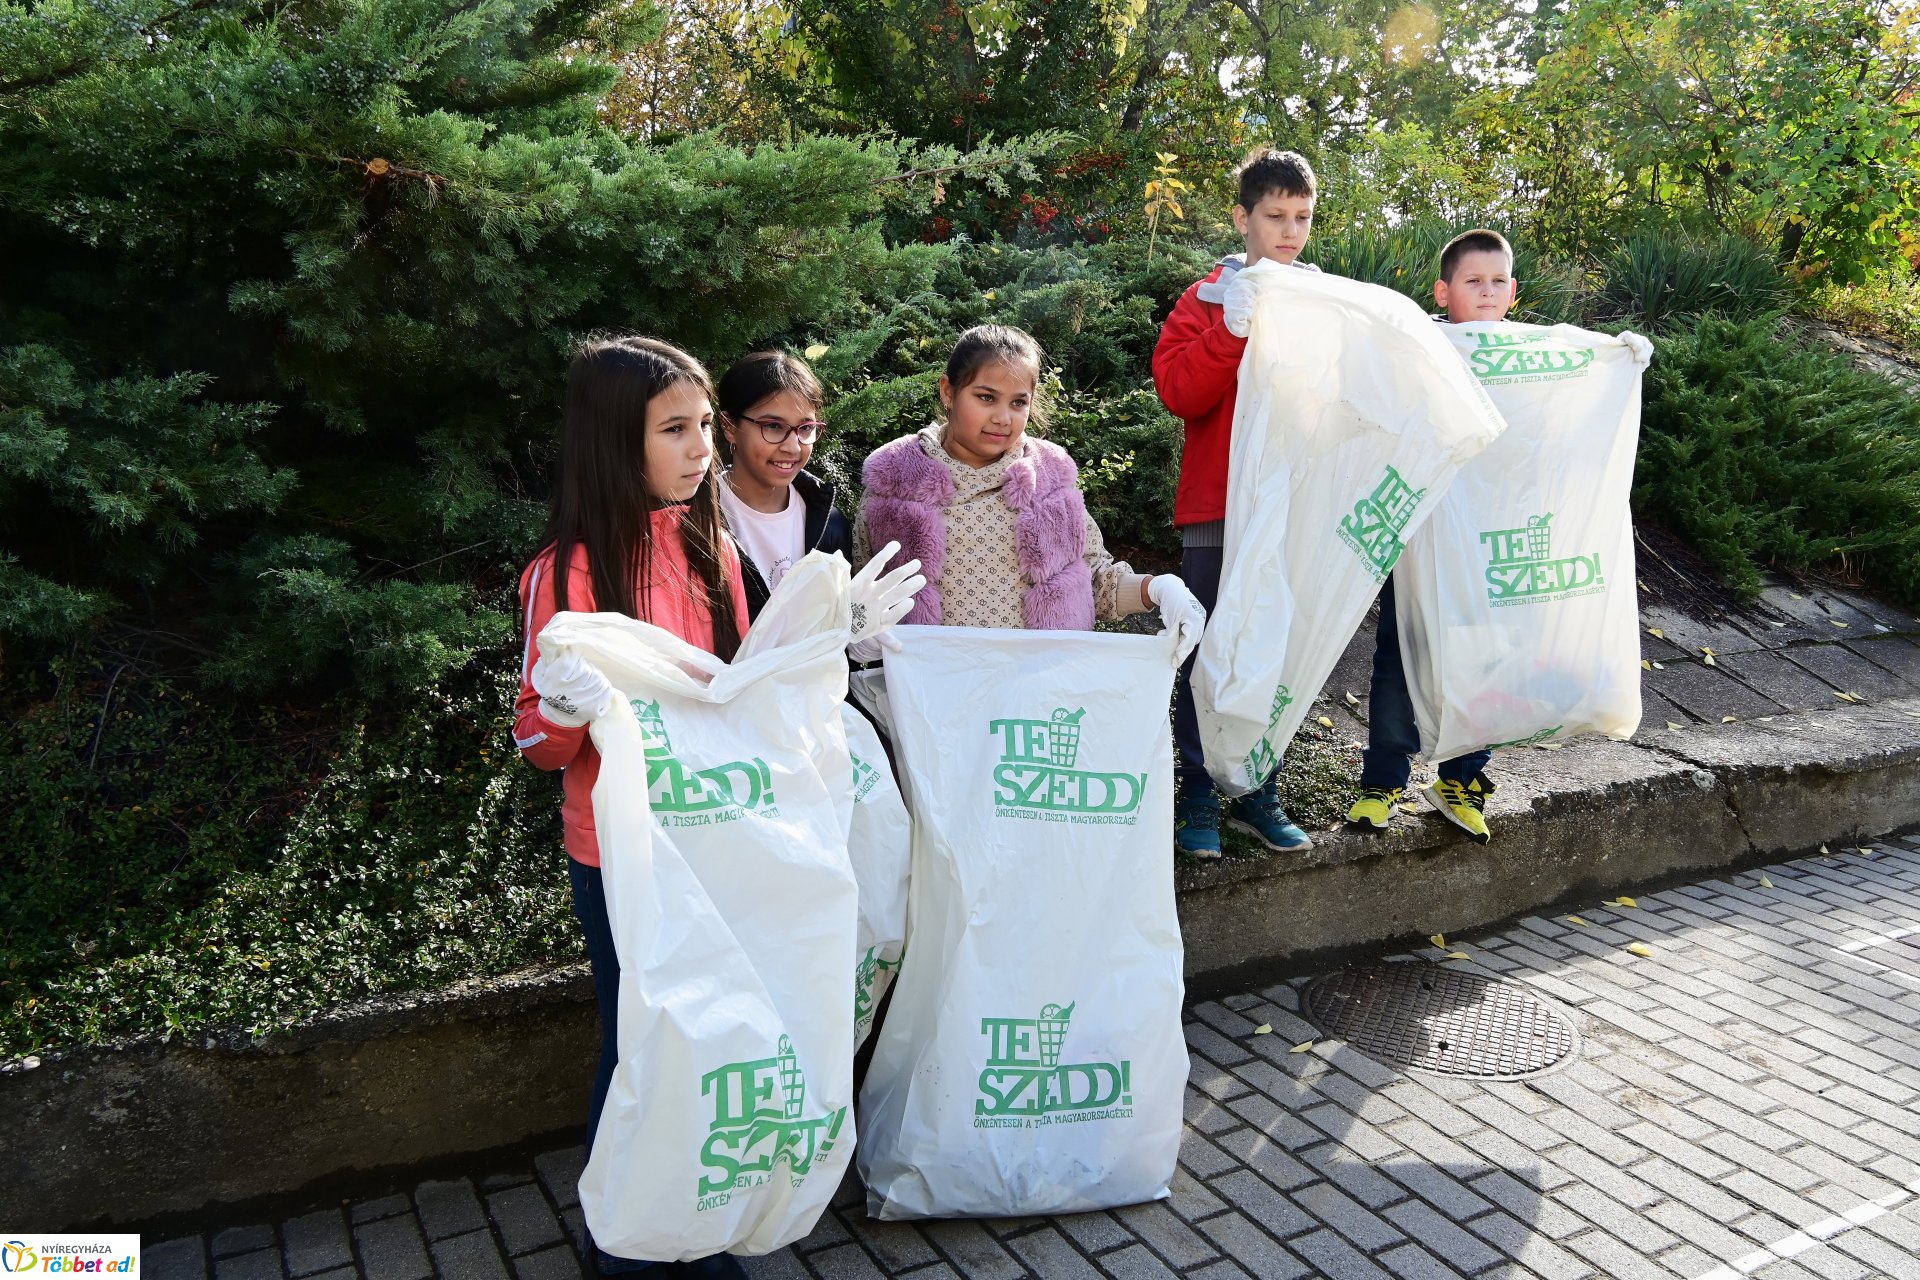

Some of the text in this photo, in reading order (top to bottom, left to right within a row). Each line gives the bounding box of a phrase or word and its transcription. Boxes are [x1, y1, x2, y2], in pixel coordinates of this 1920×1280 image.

[1369, 464, 1414, 523] TE
[1480, 528, 1531, 565] TE
[1485, 552, 1604, 599] SZEDD!
[990, 719, 1051, 765] TE
[993, 763, 1148, 815] SZEDD!
[661, 816, 669, 827] A
[673, 814, 711, 827] TISZTA
[995, 807, 1037, 820] ÖNKÉNTESEN
[1037, 812, 1042, 820] A
[1044, 812, 1069, 823] TISZTA
[981, 1018, 1041, 1067] TE
[702, 1057, 784, 1133] TE
[975, 1060, 1133, 1117] SZEDD!
[973, 1117, 1023, 1128] ÖNKÉNTESEN
[1025, 1119, 1031, 1128] A
[1054, 1108, 1133, 1124] MAGYARORSZÁGÉRT!
[756, 1176, 763, 1186] A
